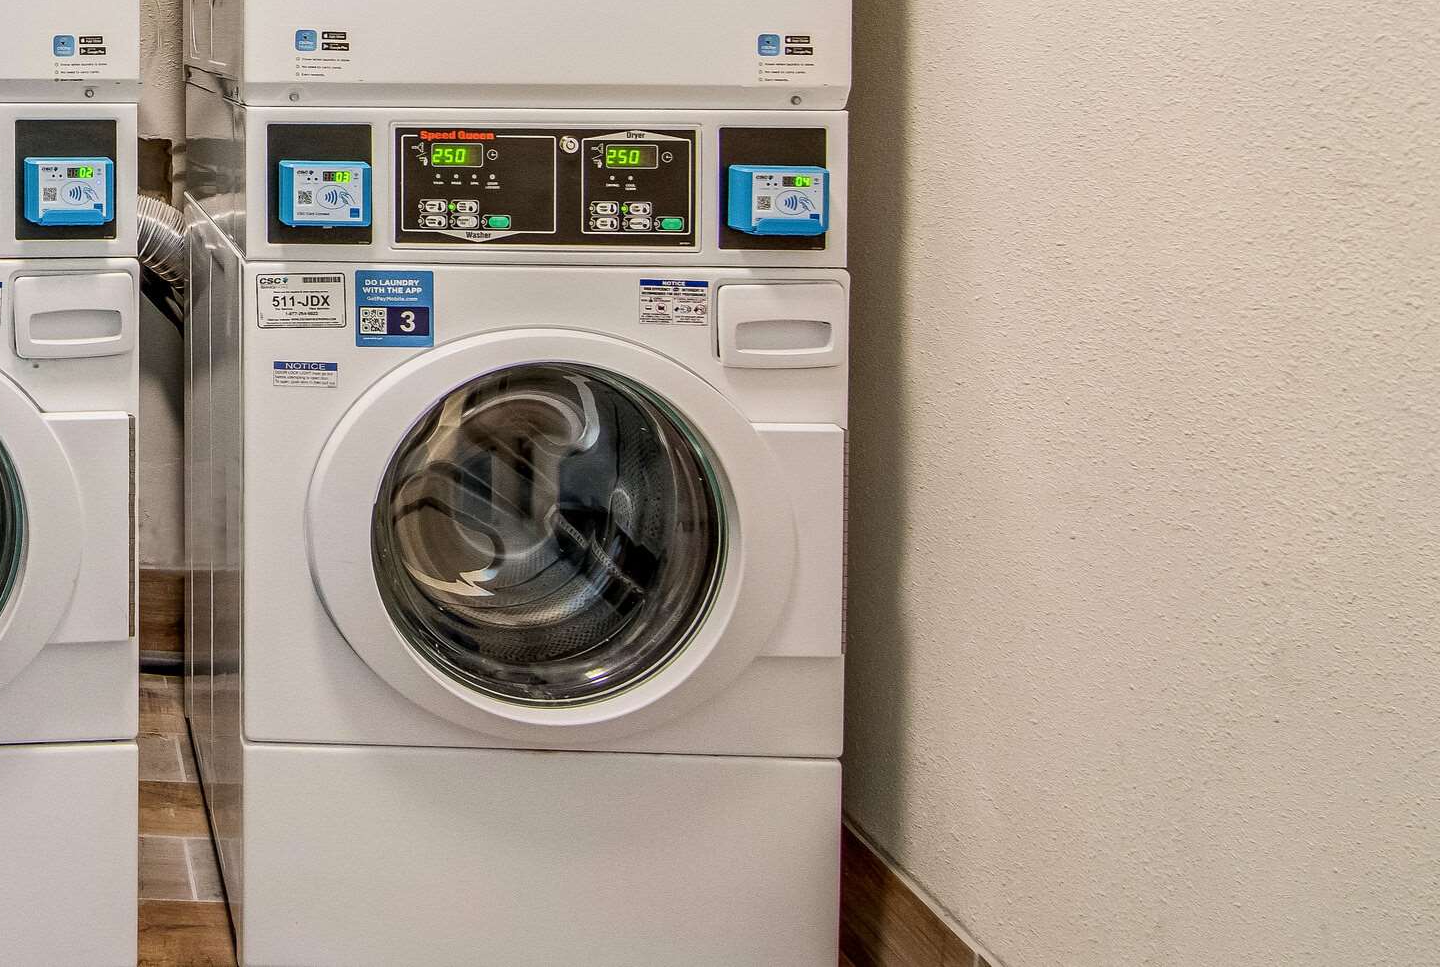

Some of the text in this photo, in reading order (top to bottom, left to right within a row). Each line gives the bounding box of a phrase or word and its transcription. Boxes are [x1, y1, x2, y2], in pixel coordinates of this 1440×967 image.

[420, 130, 495, 141] Speed Queen
[432, 148, 467, 163] 250
[607, 149, 640, 164] 250
[465, 231, 491, 239] Washer
[272, 295, 330, 307] 511-JDX
[399, 310, 415, 332] 3
[285, 362, 326, 370] NOTICE
